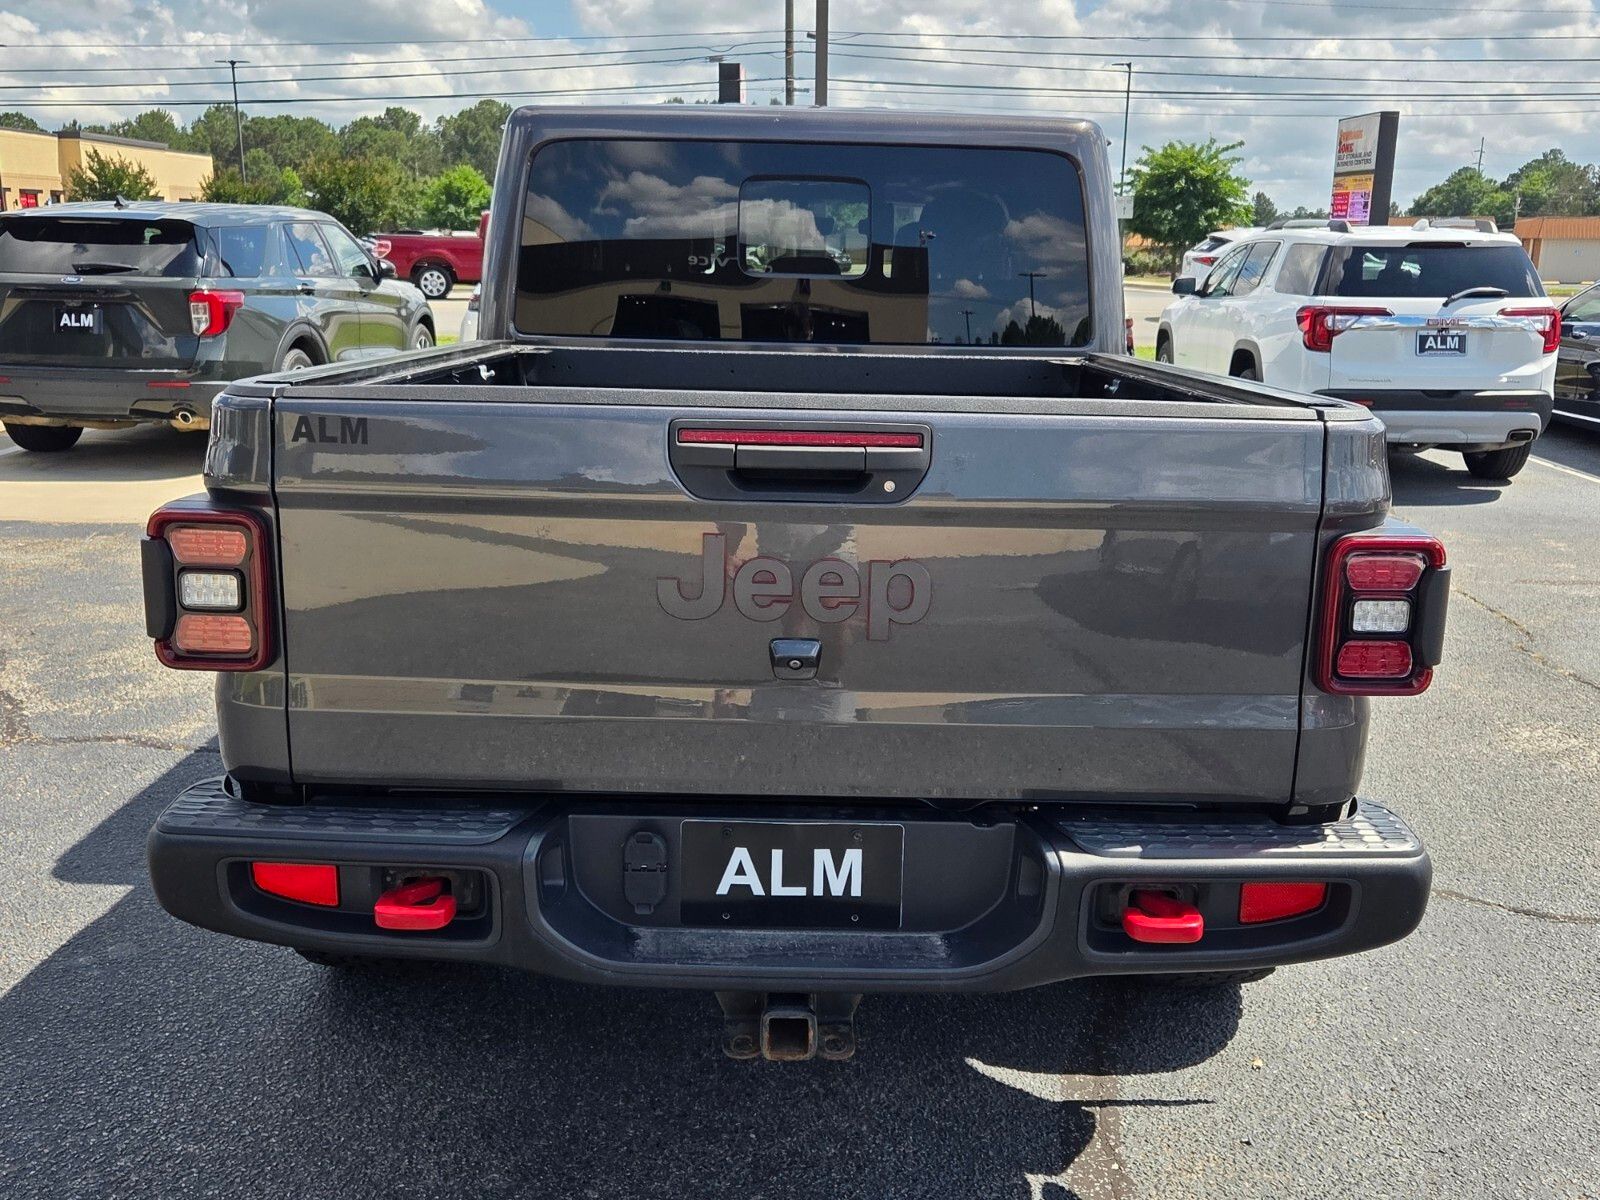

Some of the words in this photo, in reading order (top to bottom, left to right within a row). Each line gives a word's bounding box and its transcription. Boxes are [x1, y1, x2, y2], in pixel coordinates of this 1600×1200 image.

[60, 313, 93, 327] ALM
[1425, 336, 1459, 349] ALM
[291, 415, 369, 445] ALM
[656, 532, 933, 641] Jeep
[715, 846, 863, 898] ALM
